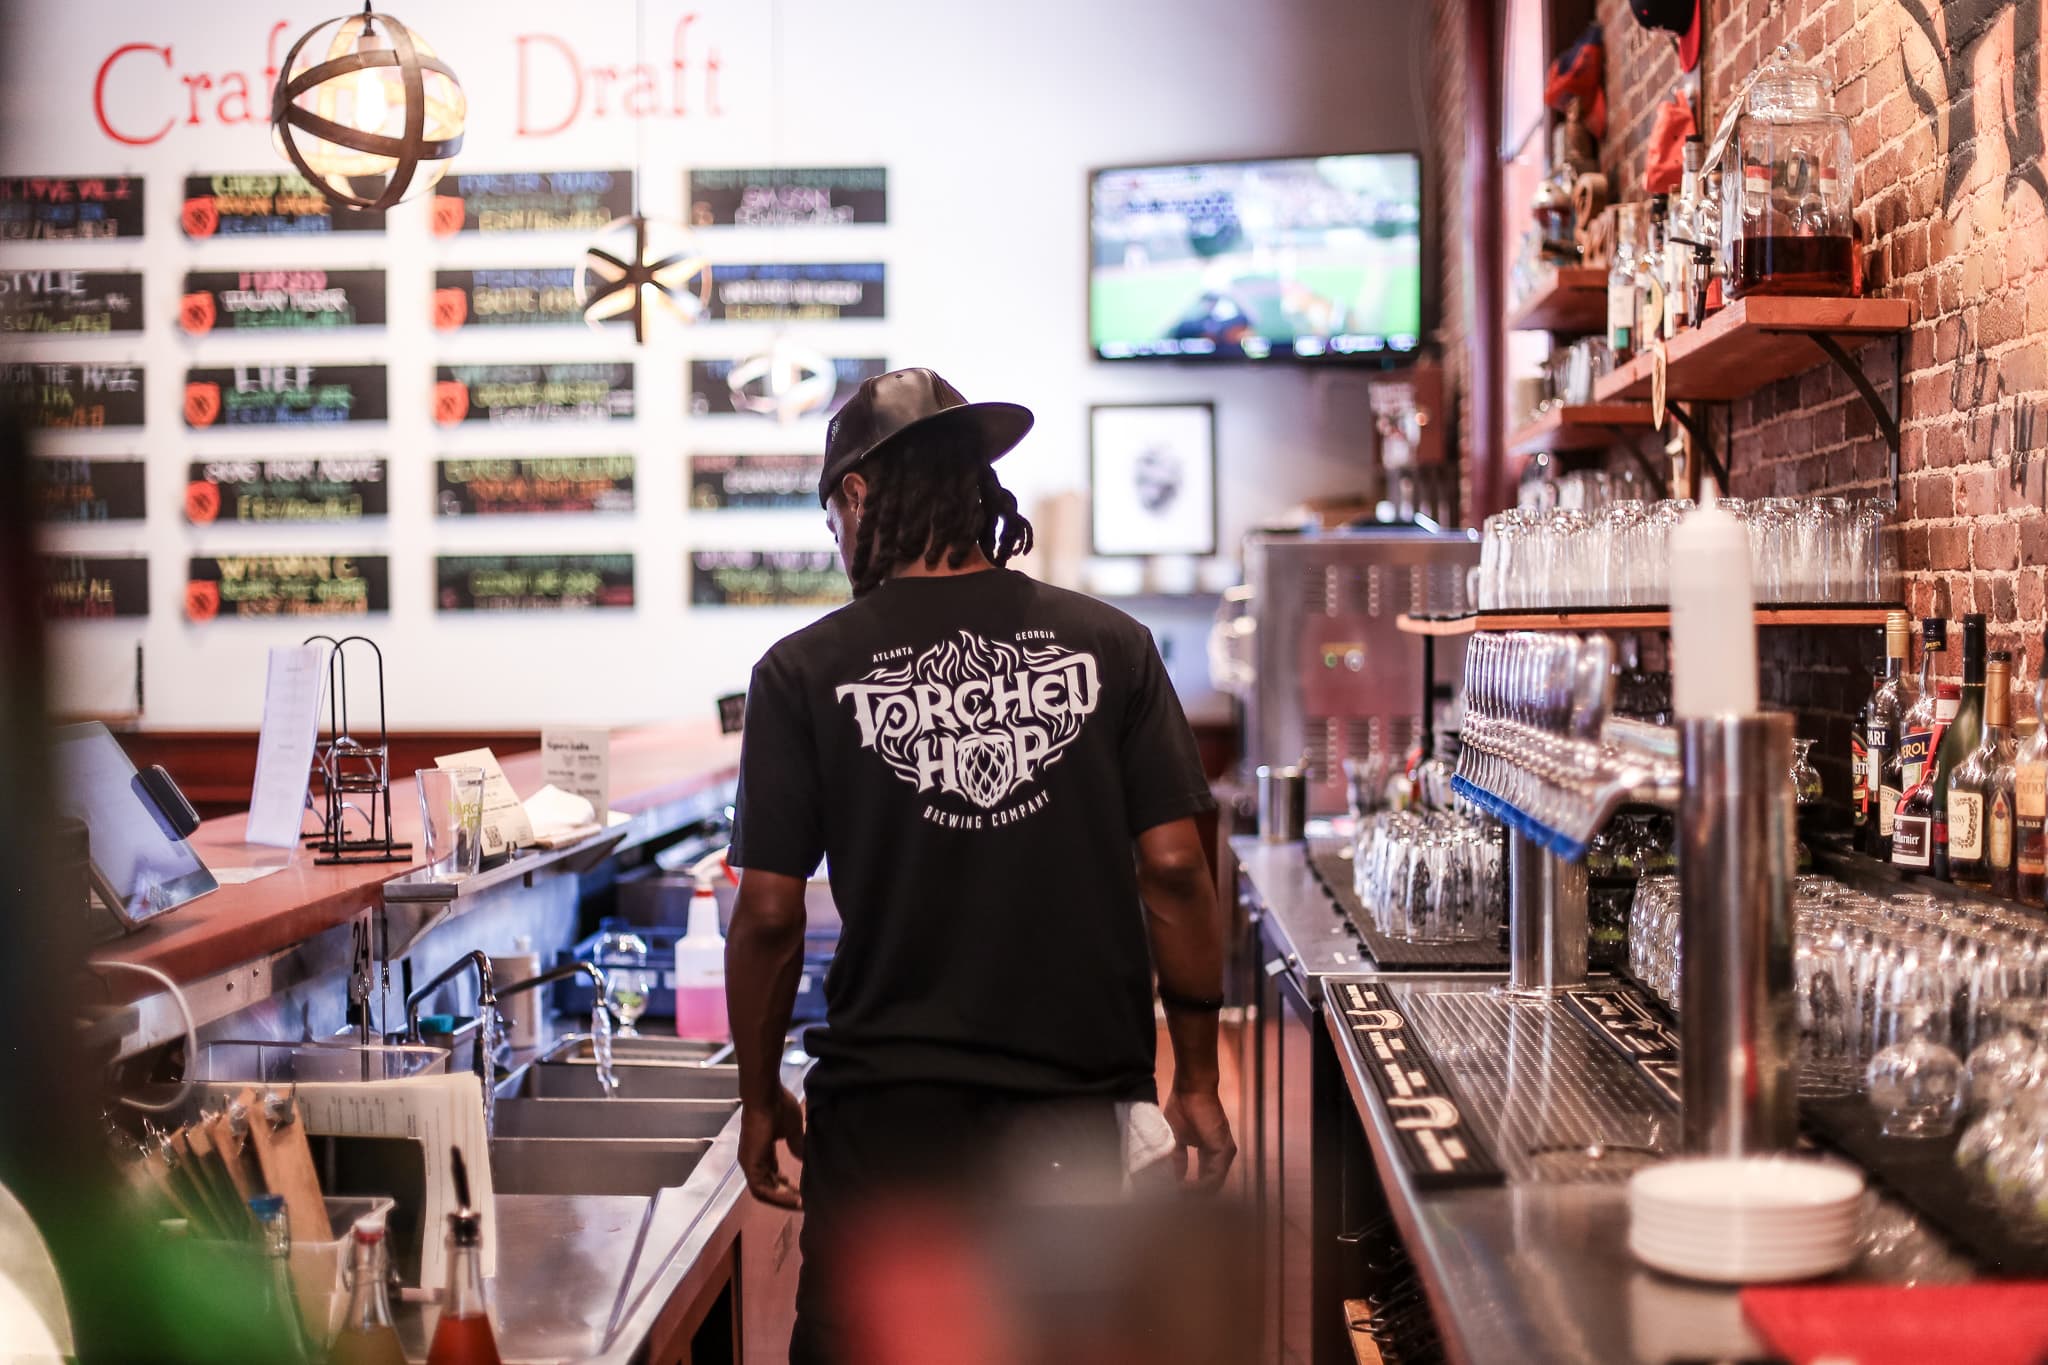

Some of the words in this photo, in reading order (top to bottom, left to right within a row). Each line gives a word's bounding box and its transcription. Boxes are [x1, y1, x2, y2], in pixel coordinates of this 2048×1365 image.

[92, 20, 304, 147] Craf
[513, 11, 726, 138] Draft
[872, 646, 914, 664] ATLANTA
[1015, 630, 1056, 642] GEORGIA
[835, 652, 1101, 748] TORCHED
[914, 722, 1050, 809] HOP
[923, 805, 983, 829] BREWING
[991, 788, 1049, 827] COMPANY
[352, 916, 369, 974] 24
